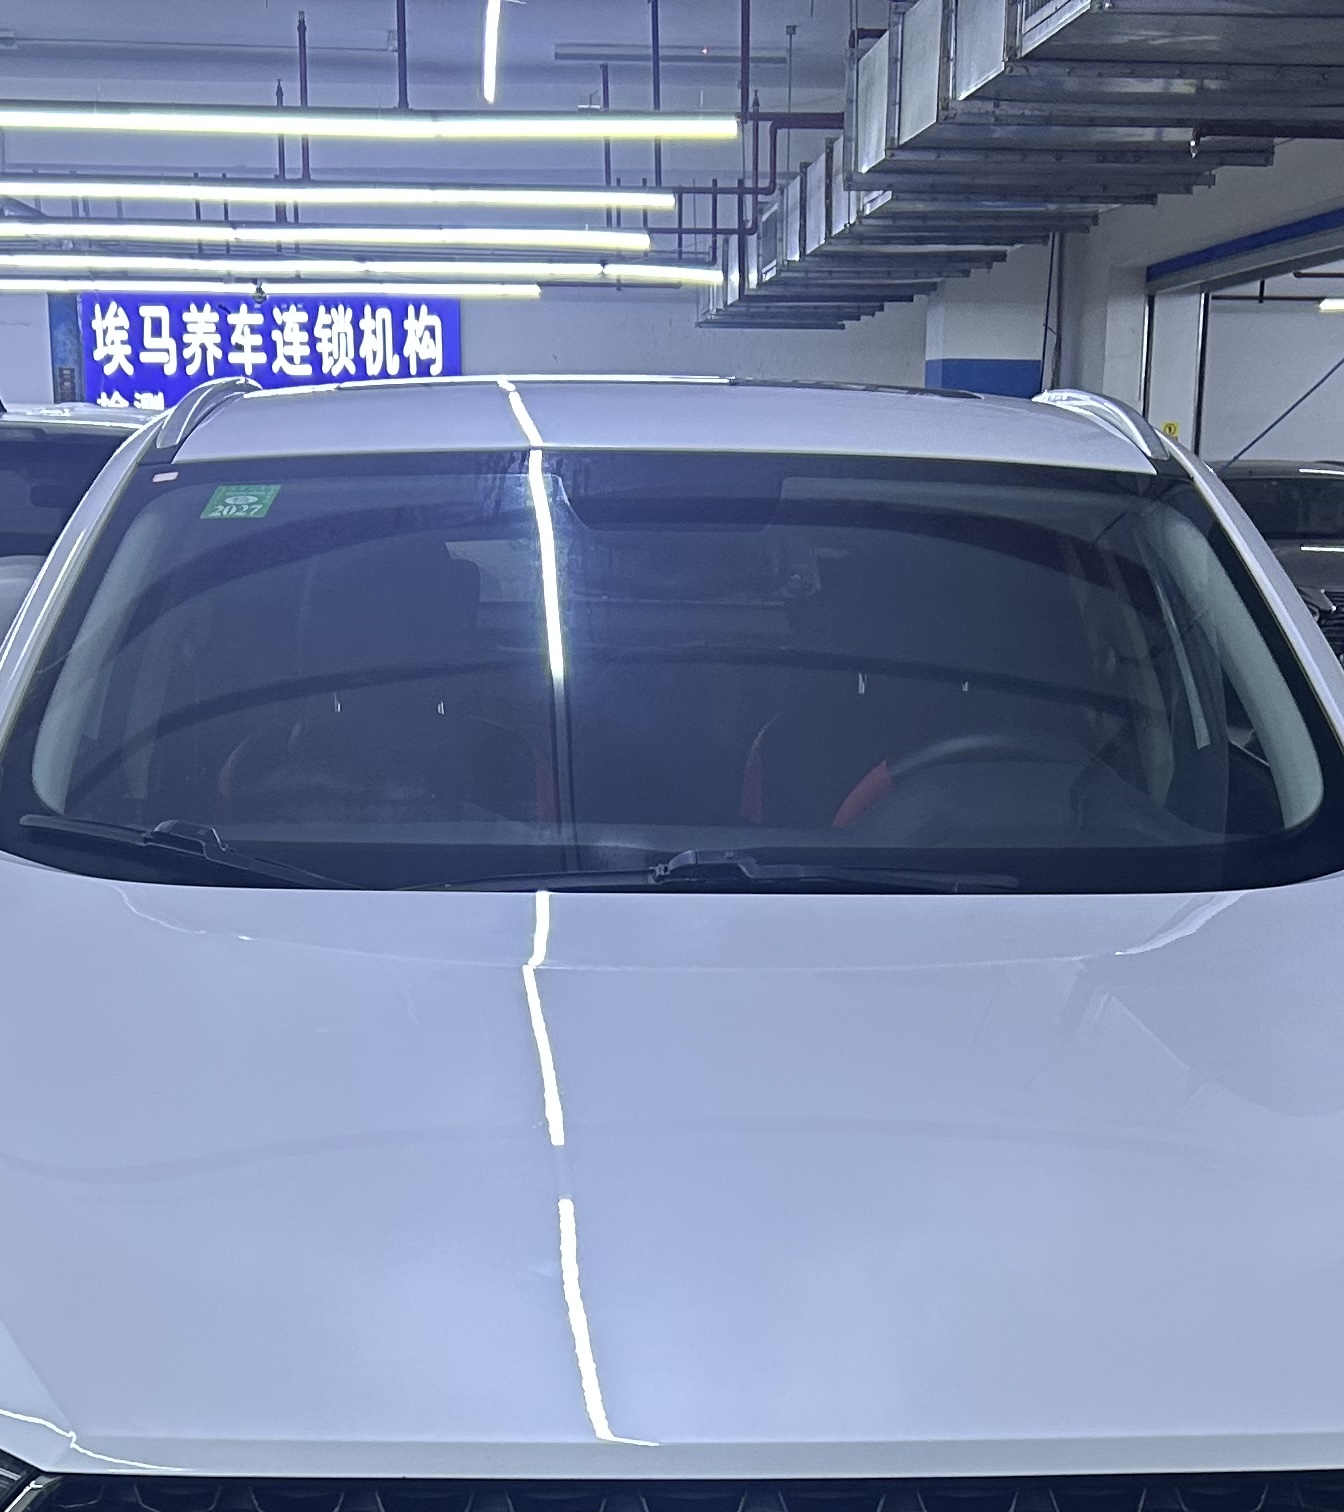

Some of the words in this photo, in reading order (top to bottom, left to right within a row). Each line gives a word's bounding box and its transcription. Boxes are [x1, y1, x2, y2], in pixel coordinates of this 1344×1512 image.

[91, 301, 444, 376] 埃马养车连锁机构
[207, 504, 264, 517] 2027
